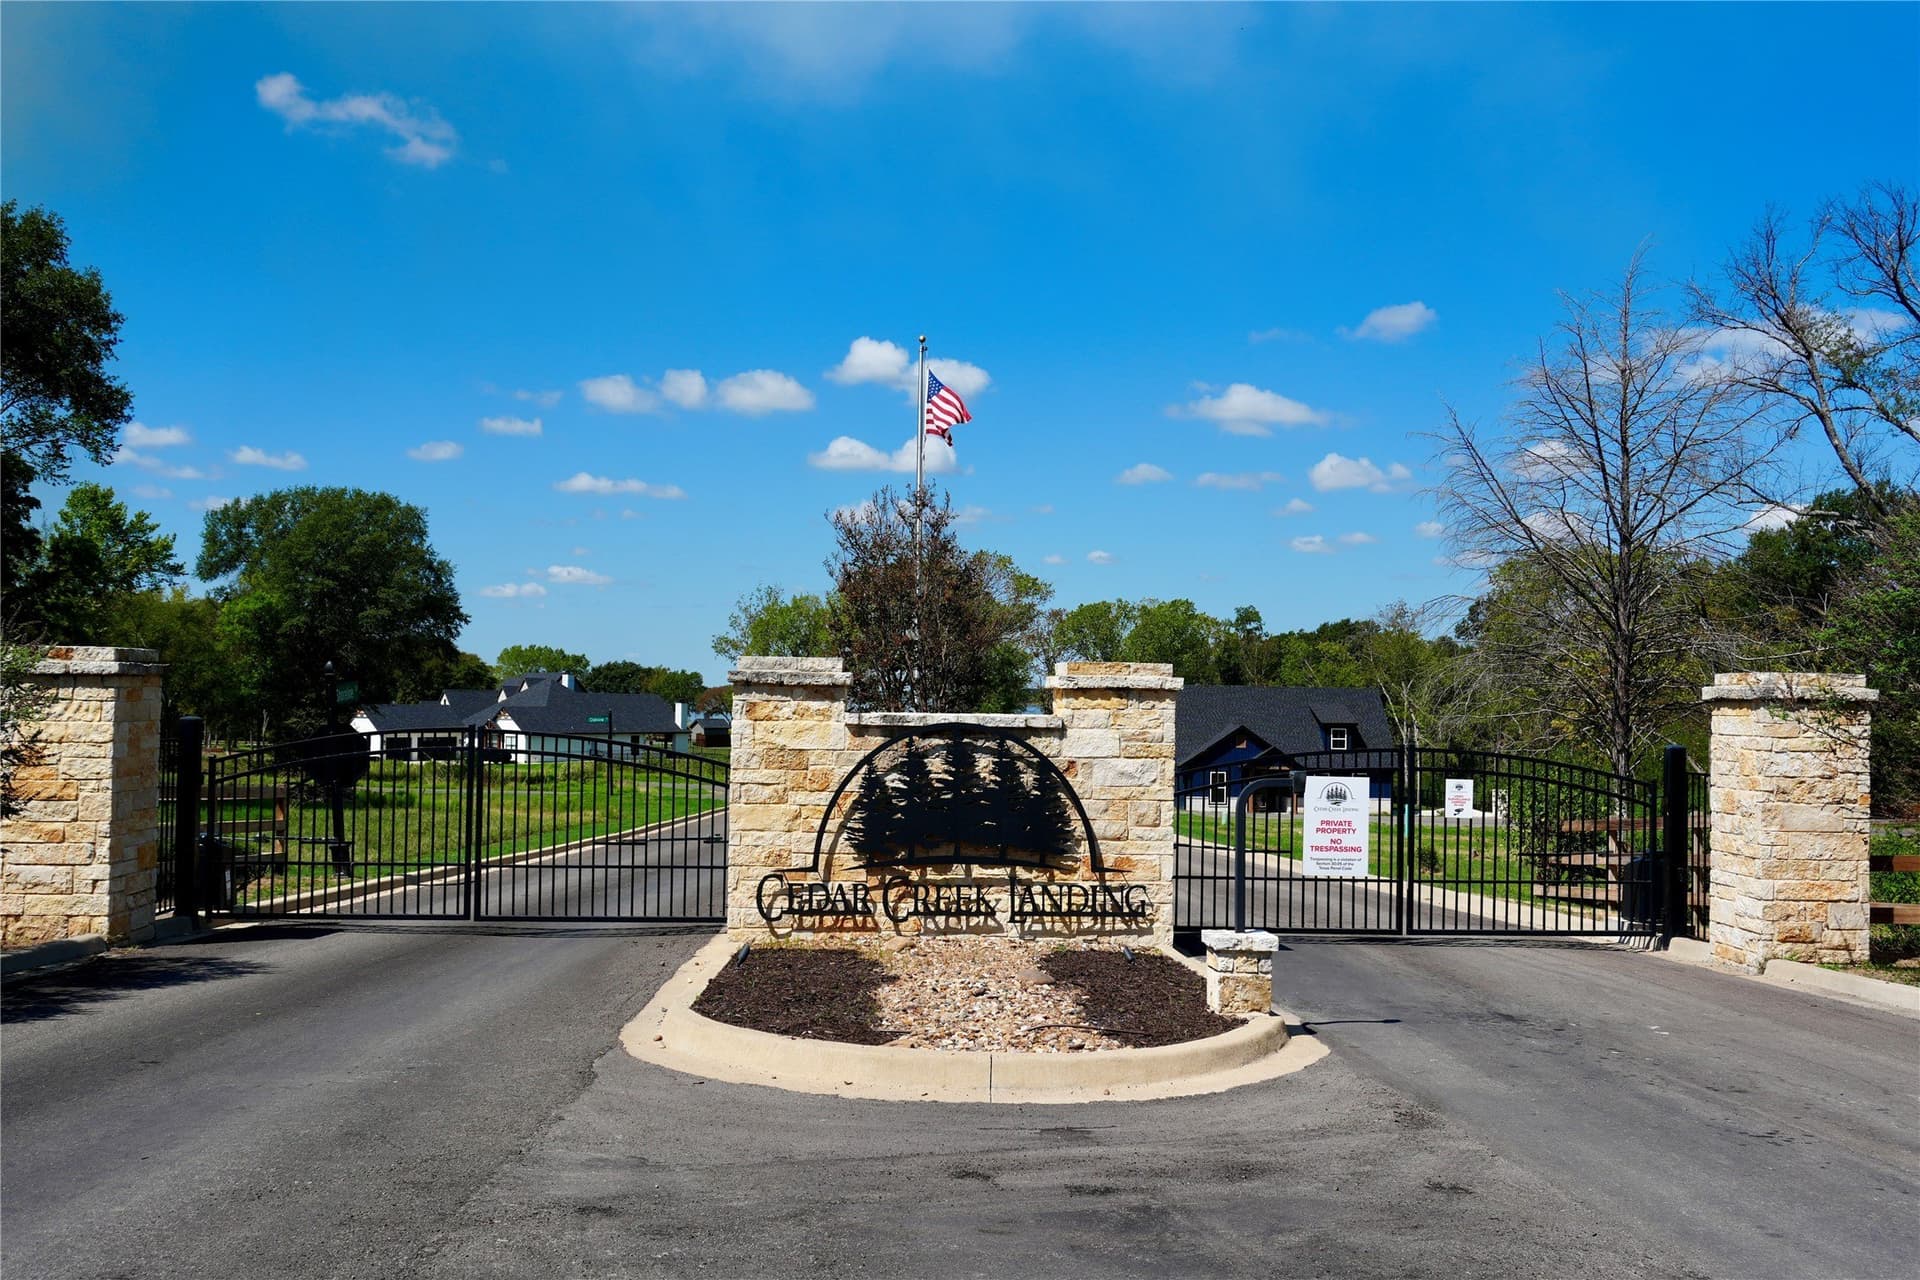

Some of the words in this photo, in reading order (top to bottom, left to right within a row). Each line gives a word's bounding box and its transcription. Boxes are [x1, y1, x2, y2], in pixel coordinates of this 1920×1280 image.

[1320, 819, 1353, 827] PRIVATE
[1315, 827, 1357, 835] PROPERTY
[1310, 845, 1363, 853] TRESPASSING
[755, 873, 874, 922] CEDAR
[882, 875, 997, 923] CREEK
[1007, 876, 1148, 924] LANDING
